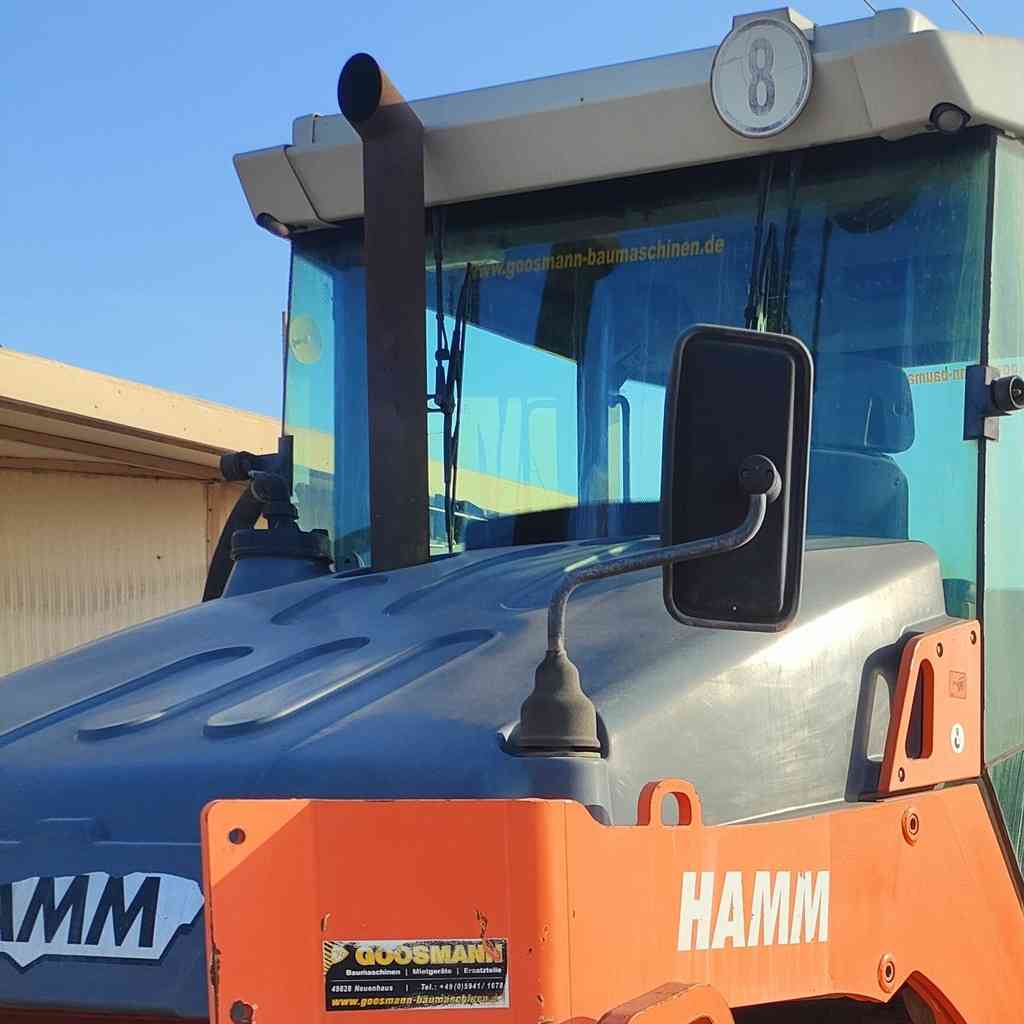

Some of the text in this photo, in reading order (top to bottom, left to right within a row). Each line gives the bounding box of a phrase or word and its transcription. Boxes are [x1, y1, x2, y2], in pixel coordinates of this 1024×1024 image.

[748, 38, 776, 116] 8
[677, 870, 831, 952] HAMM
[354, 943, 505, 966] GOOSMANN
